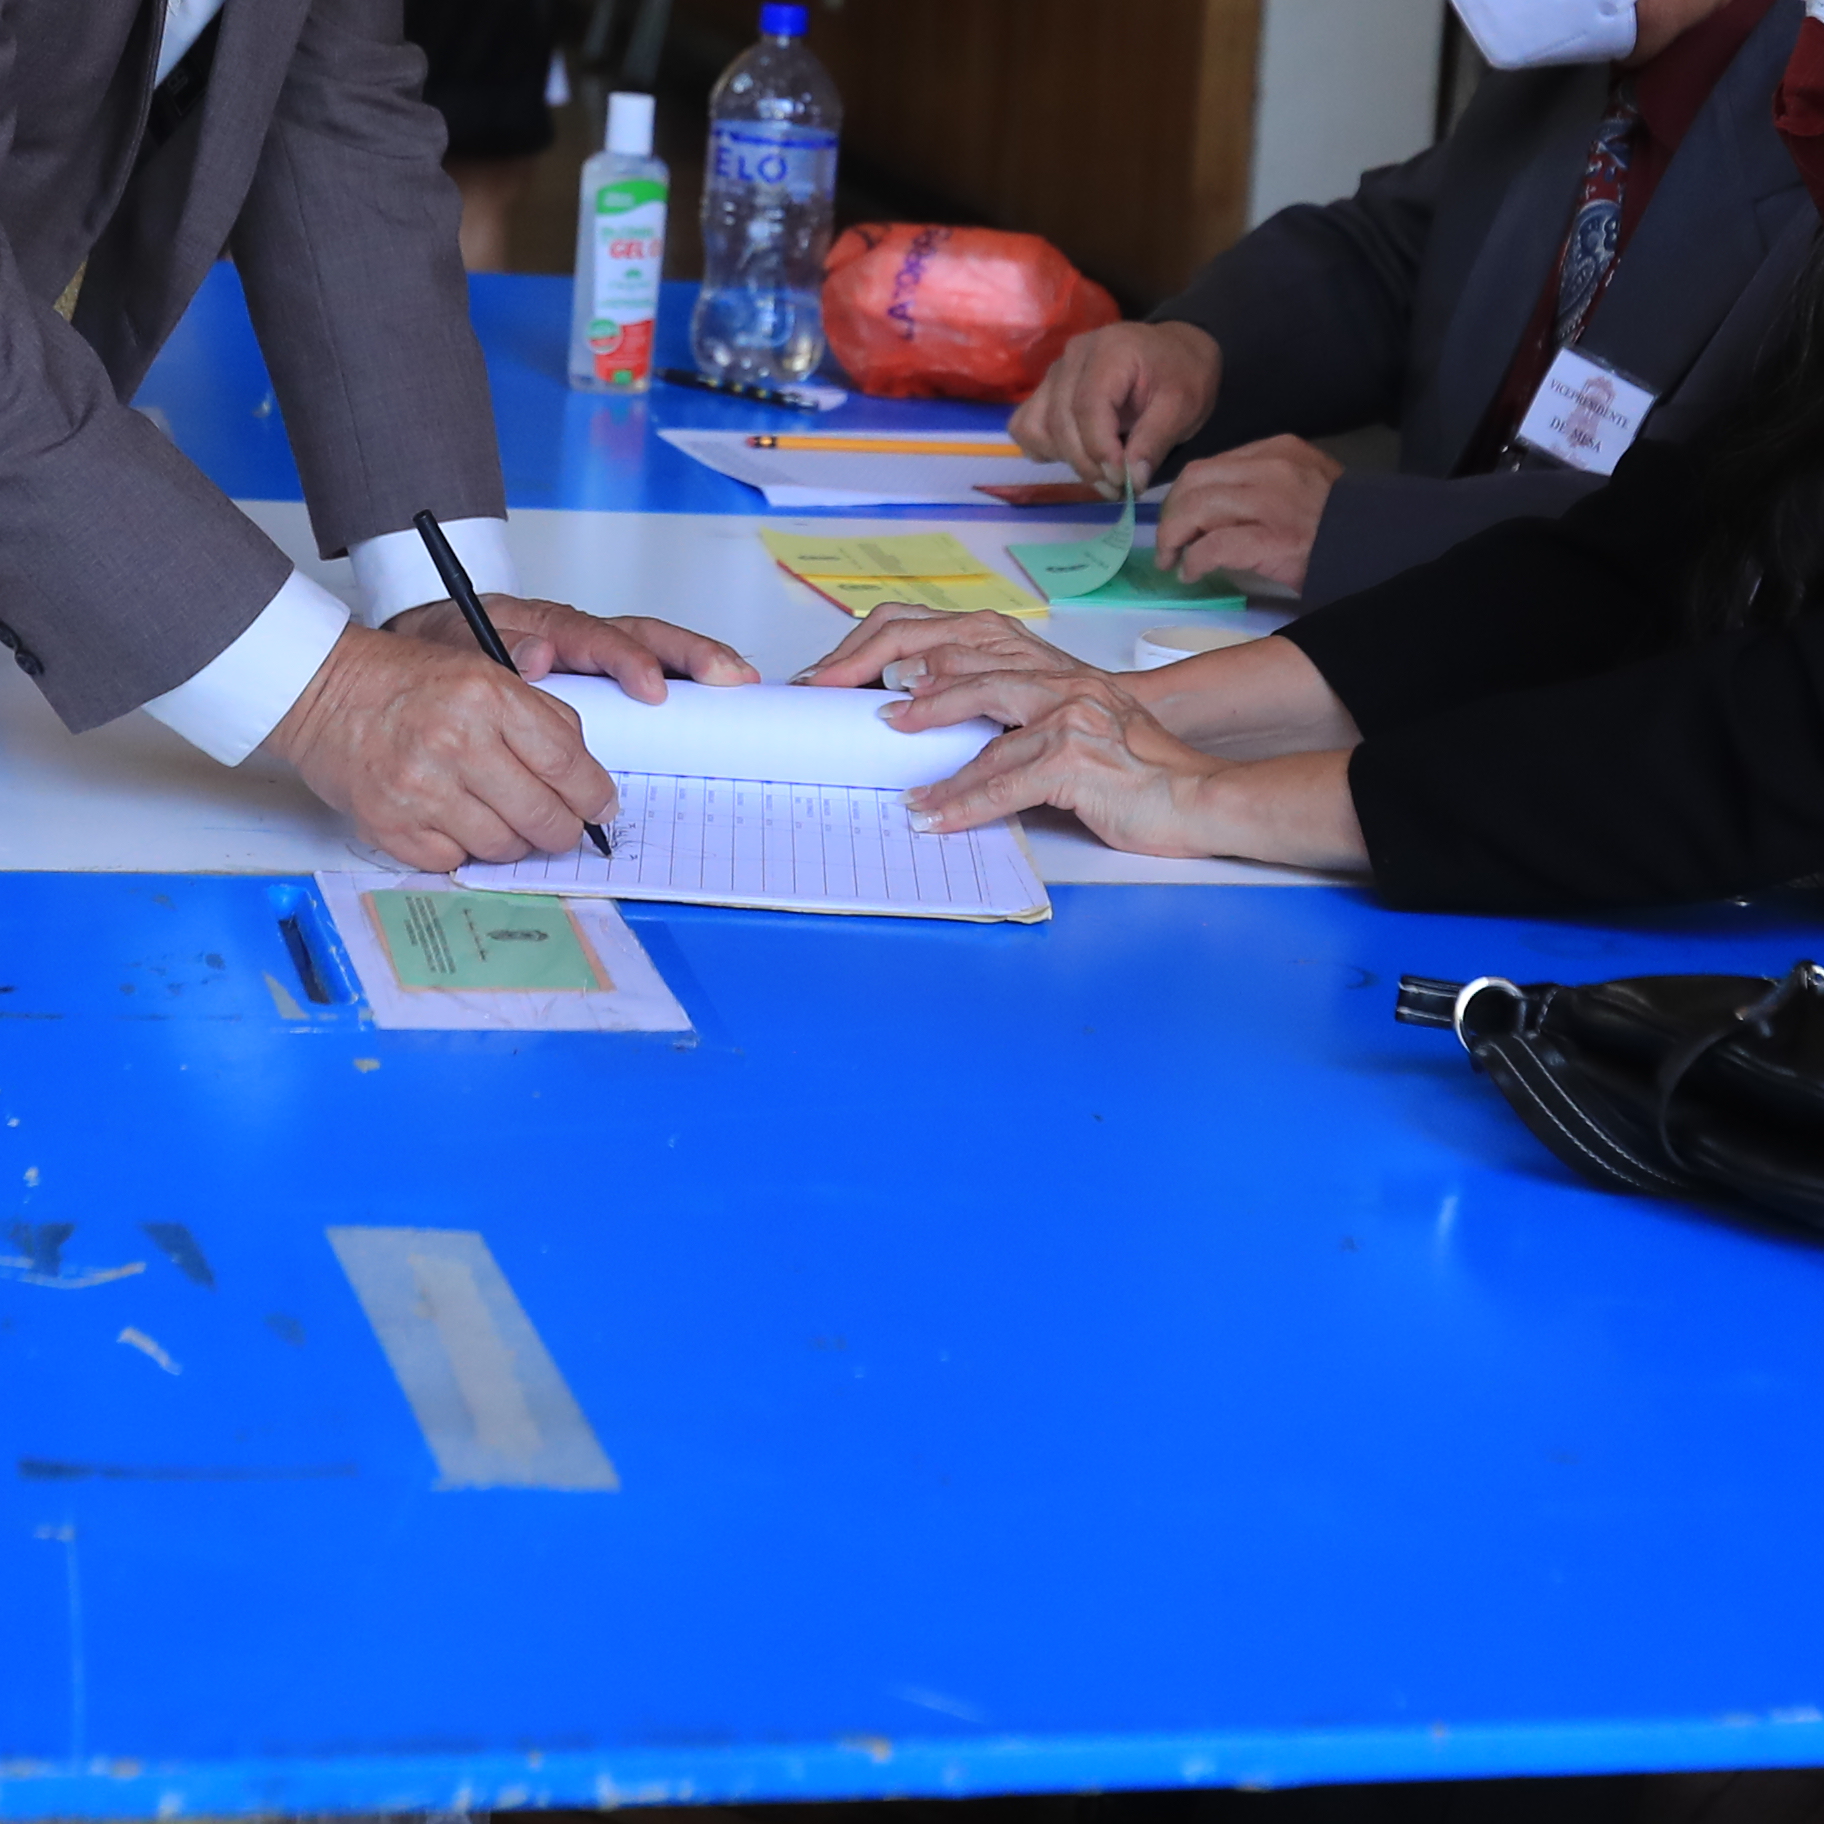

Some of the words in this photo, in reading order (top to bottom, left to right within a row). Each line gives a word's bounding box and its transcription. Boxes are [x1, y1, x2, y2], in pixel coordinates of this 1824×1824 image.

[1550, 379, 1629, 428] VICEPRESIDENTE
[1550, 418, 1567, 432] DE
[1571, 430, 1602, 453] MESA
